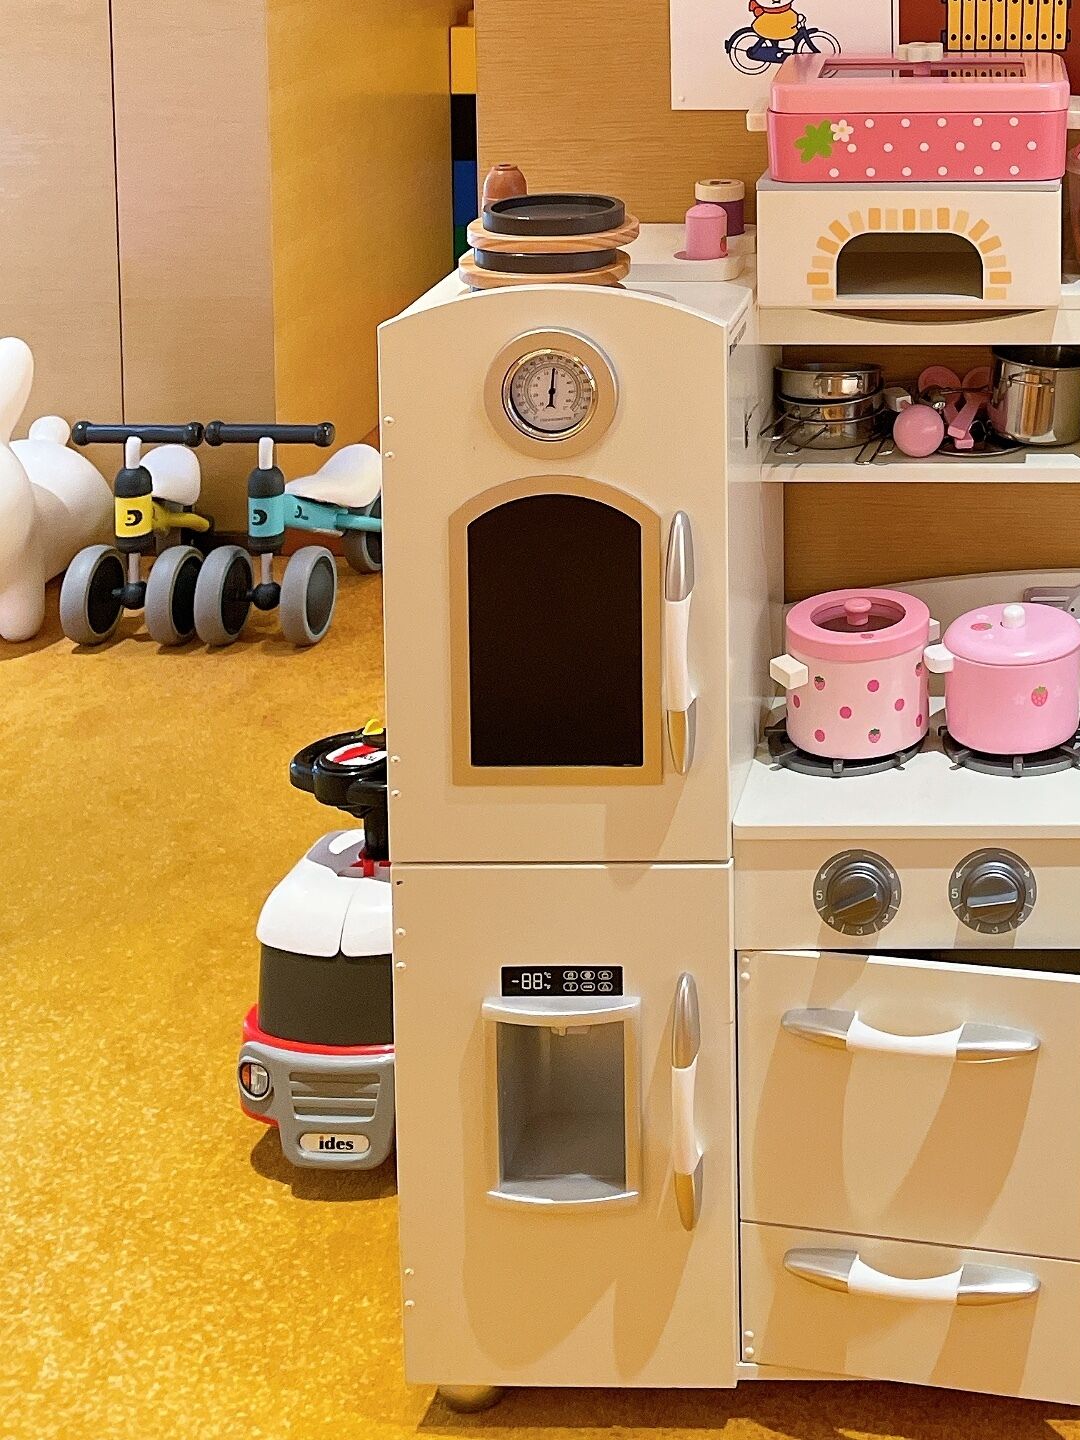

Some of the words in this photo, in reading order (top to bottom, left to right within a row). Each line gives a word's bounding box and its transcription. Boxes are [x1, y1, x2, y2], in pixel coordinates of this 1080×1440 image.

[815, 889, 823, 901] 5
[893, 890, 898, 900] 1
[951, 887, 959, 899] 5
[1028, 889, 1034, 899] 1
[828, 916, 835, 925] 4
[882, 913, 889, 923] 2
[963, 913, 970, 923] 4
[1017, 912, 1024, 921] 2
[318, 1134, 354, 1151] ides
